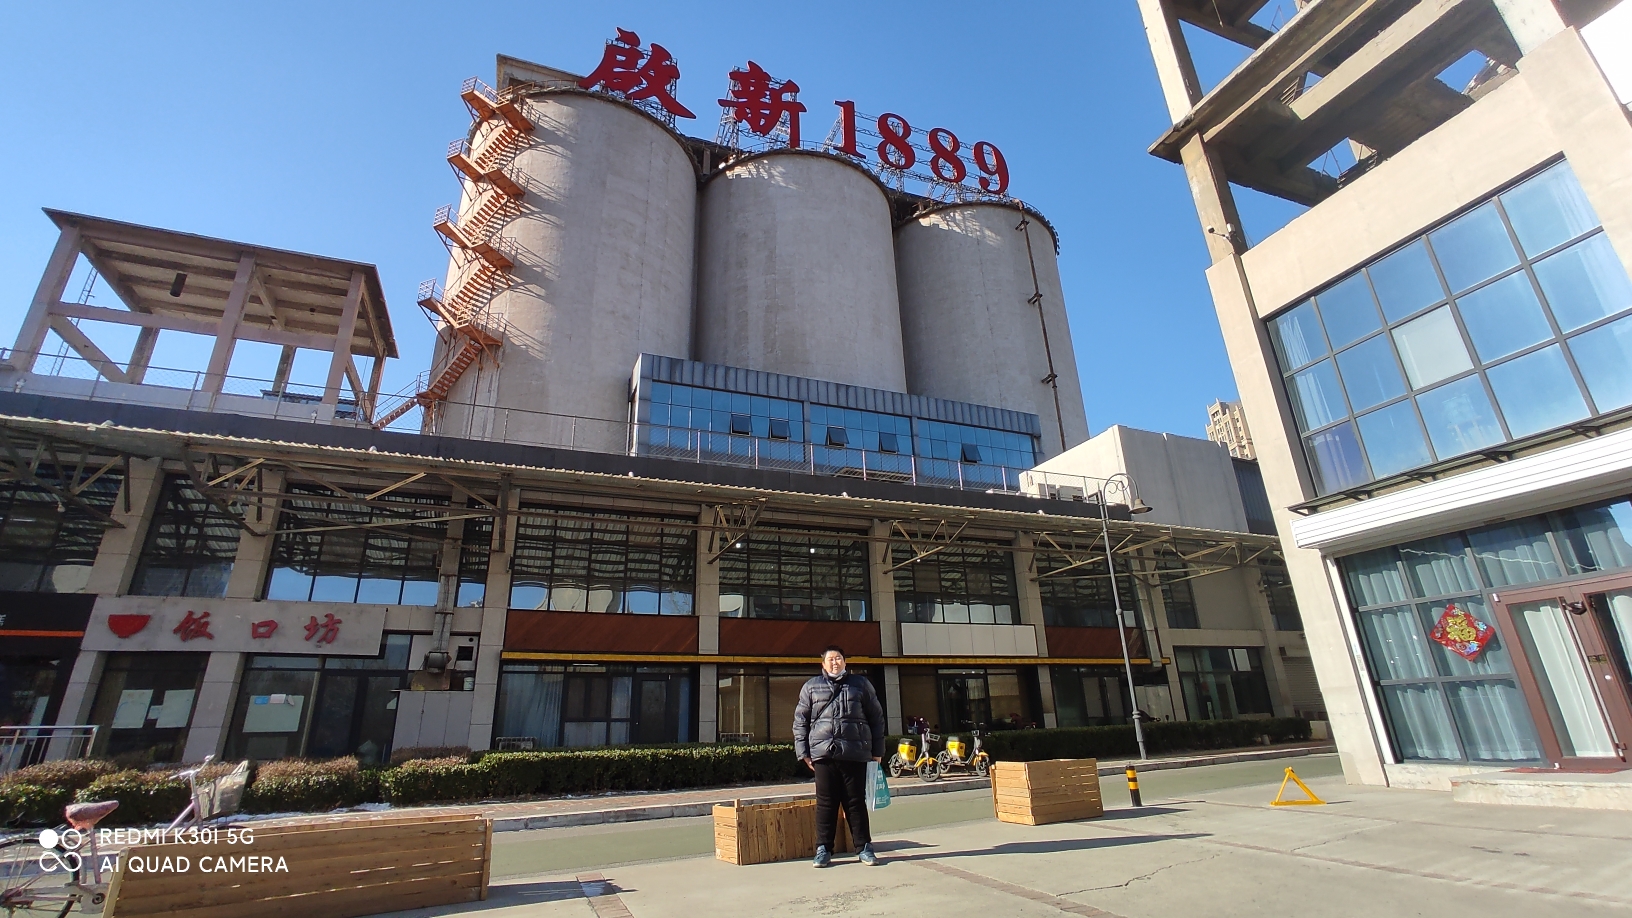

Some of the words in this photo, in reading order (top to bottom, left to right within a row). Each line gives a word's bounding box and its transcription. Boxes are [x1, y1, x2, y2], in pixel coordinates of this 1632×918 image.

[833, 99, 1011, 195] 1889
[173, 610, 343, 645] 饭口坊
